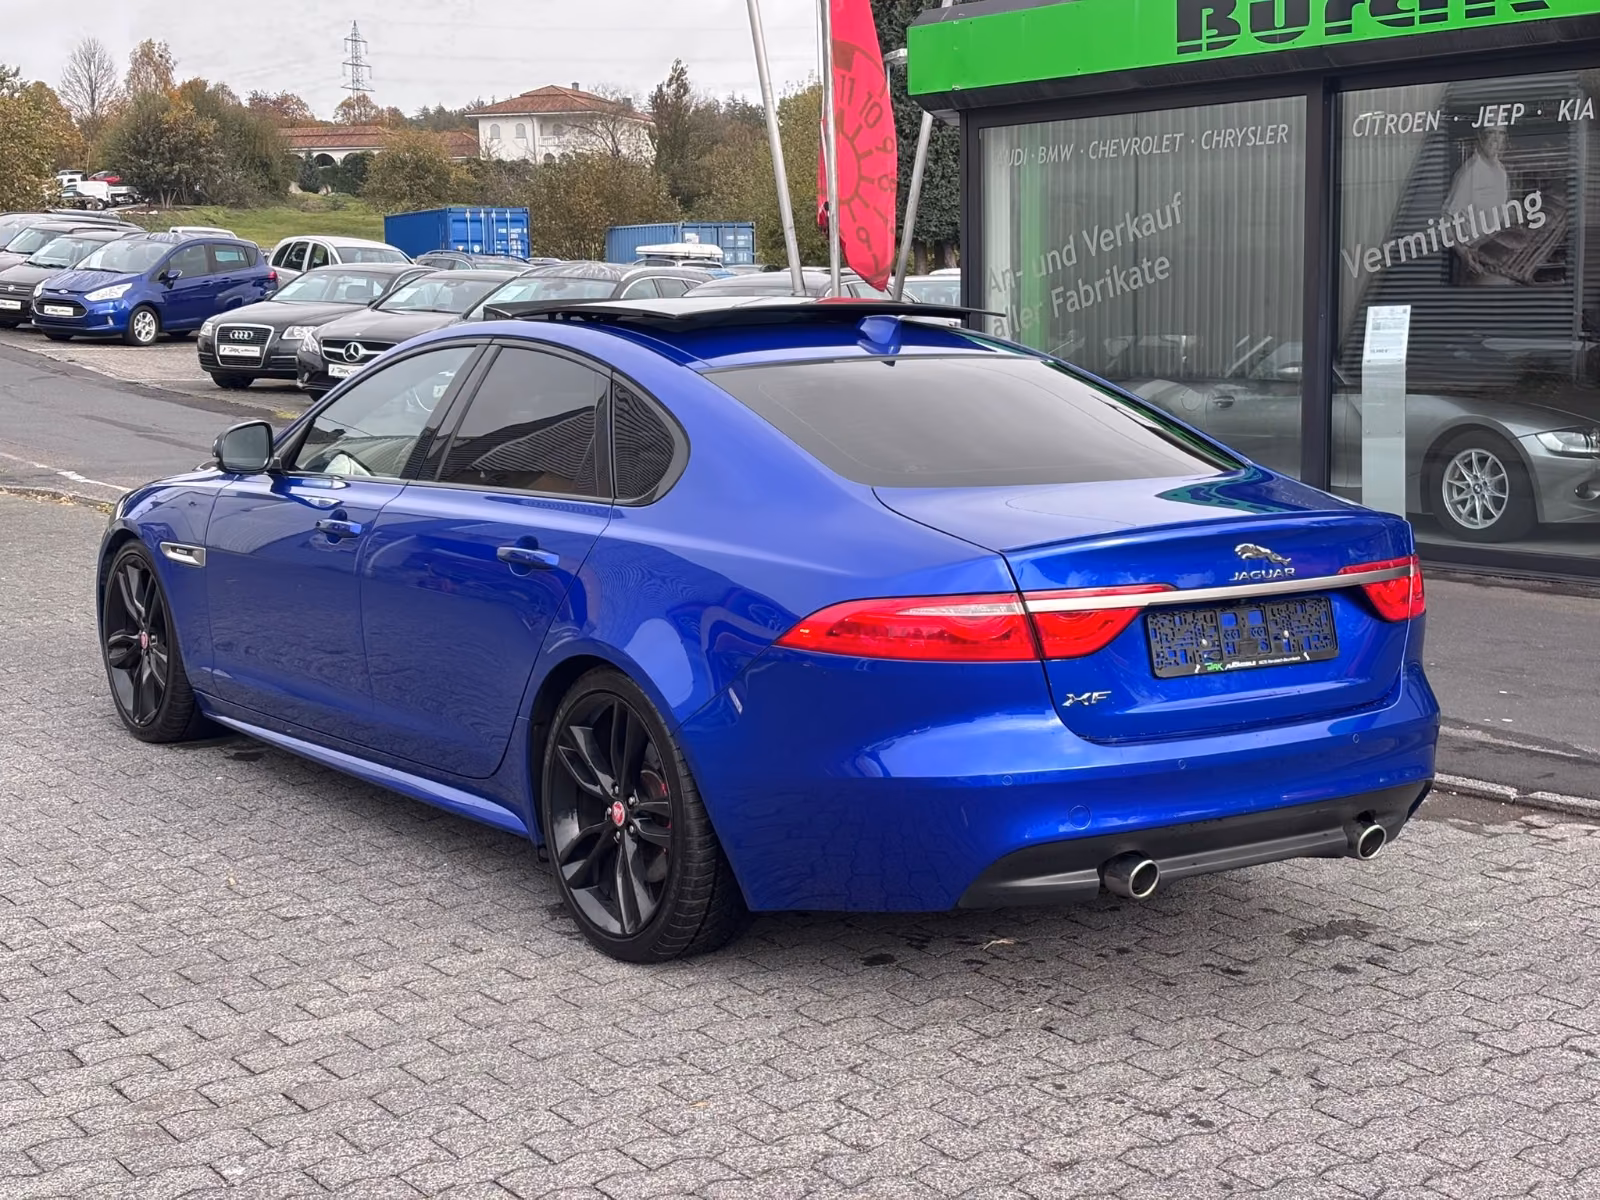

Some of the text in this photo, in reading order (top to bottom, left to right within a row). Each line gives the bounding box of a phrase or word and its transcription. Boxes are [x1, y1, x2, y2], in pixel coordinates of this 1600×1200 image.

[840, 74, 856, 106] 11
[859, 92, 884, 129] 10
[1352, 97, 1595, 138] CITROEN JEEP KIA
[1038, 143, 1074, 165] BMW
[1088, 132, 1185, 160] CHEVROLET
[1201, 123, 1289, 151] CHRYSLER
[877, 173, 897, 193] 8
[988, 191, 1183, 297] An- und Verkauf
[1341, 190, 1547, 278] Vermittlung
[994, 255, 1171, 338] aller Fabrikate
[1229, 567, 1296, 581] JAGUAR
[1062, 690, 1112, 707] XF
